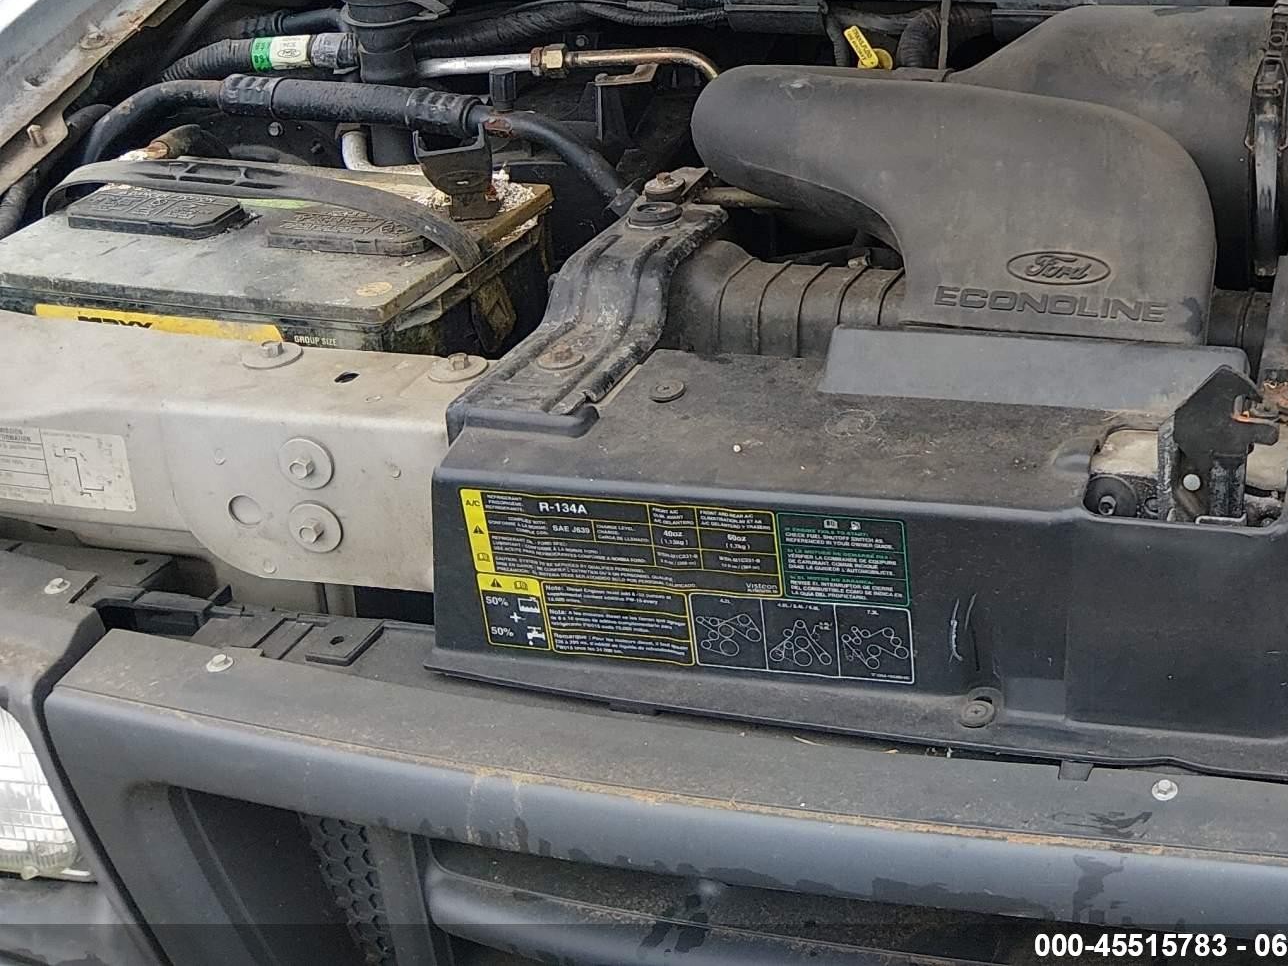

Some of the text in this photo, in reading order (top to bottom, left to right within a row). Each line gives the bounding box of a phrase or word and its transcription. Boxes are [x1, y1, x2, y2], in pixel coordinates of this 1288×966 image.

[1024, 255, 1092, 280] Ford
[934, 285, 1169, 322] ECONOLINE
[294, 335, 336, 346] GROUP SIZE
[538, 501, 587, 514] R-134A
[551, 524, 569, 532] SAE
[727, 533, 747, 541] 60oz
[745, 581, 777, 590] Visteon
[486, 595, 509, 607] 50%
[491, 626, 514, 637] 50%
